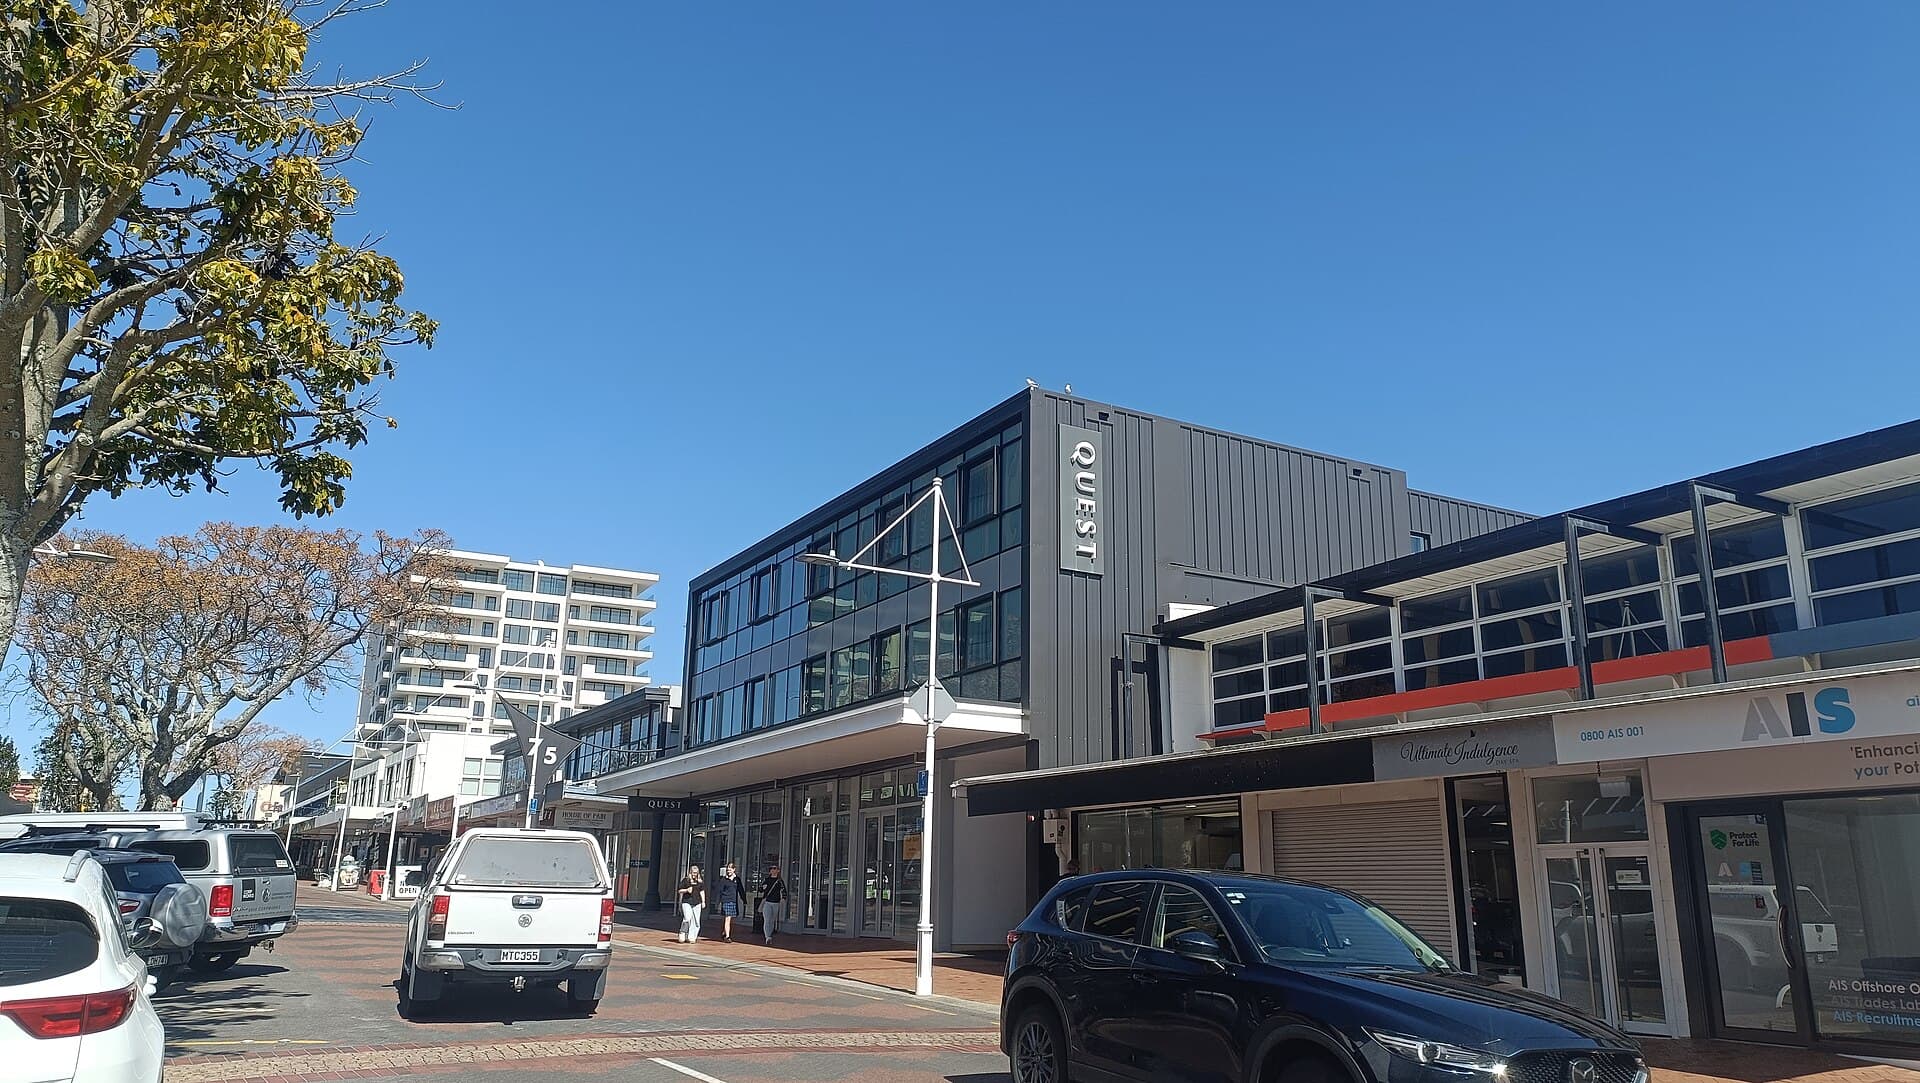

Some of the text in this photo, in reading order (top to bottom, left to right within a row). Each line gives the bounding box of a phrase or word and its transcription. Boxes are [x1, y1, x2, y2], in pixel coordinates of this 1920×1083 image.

[1070, 441, 1098, 559] QUEST
[1741, 687, 1855, 741] AIS
[1580, 726, 1644, 741] 0800 AIS 001
[1400, 739, 1520, 765] Ultimate Indulgence
[1849, 741, 1920, 759] 'Enhanci
[1854, 765, 1889, 780] your
[648, 799, 681, 809] QUEST
[1729, 831, 1758, 840] Protect
[1733, 838, 1760, 847] For Life
[501, 950, 539, 962] MTC355
[1828, 980, 1848, 992] AIS
[1851, 980, 1906, 994] Offshore
[1834, 1009, 1852, 1023] AIS
